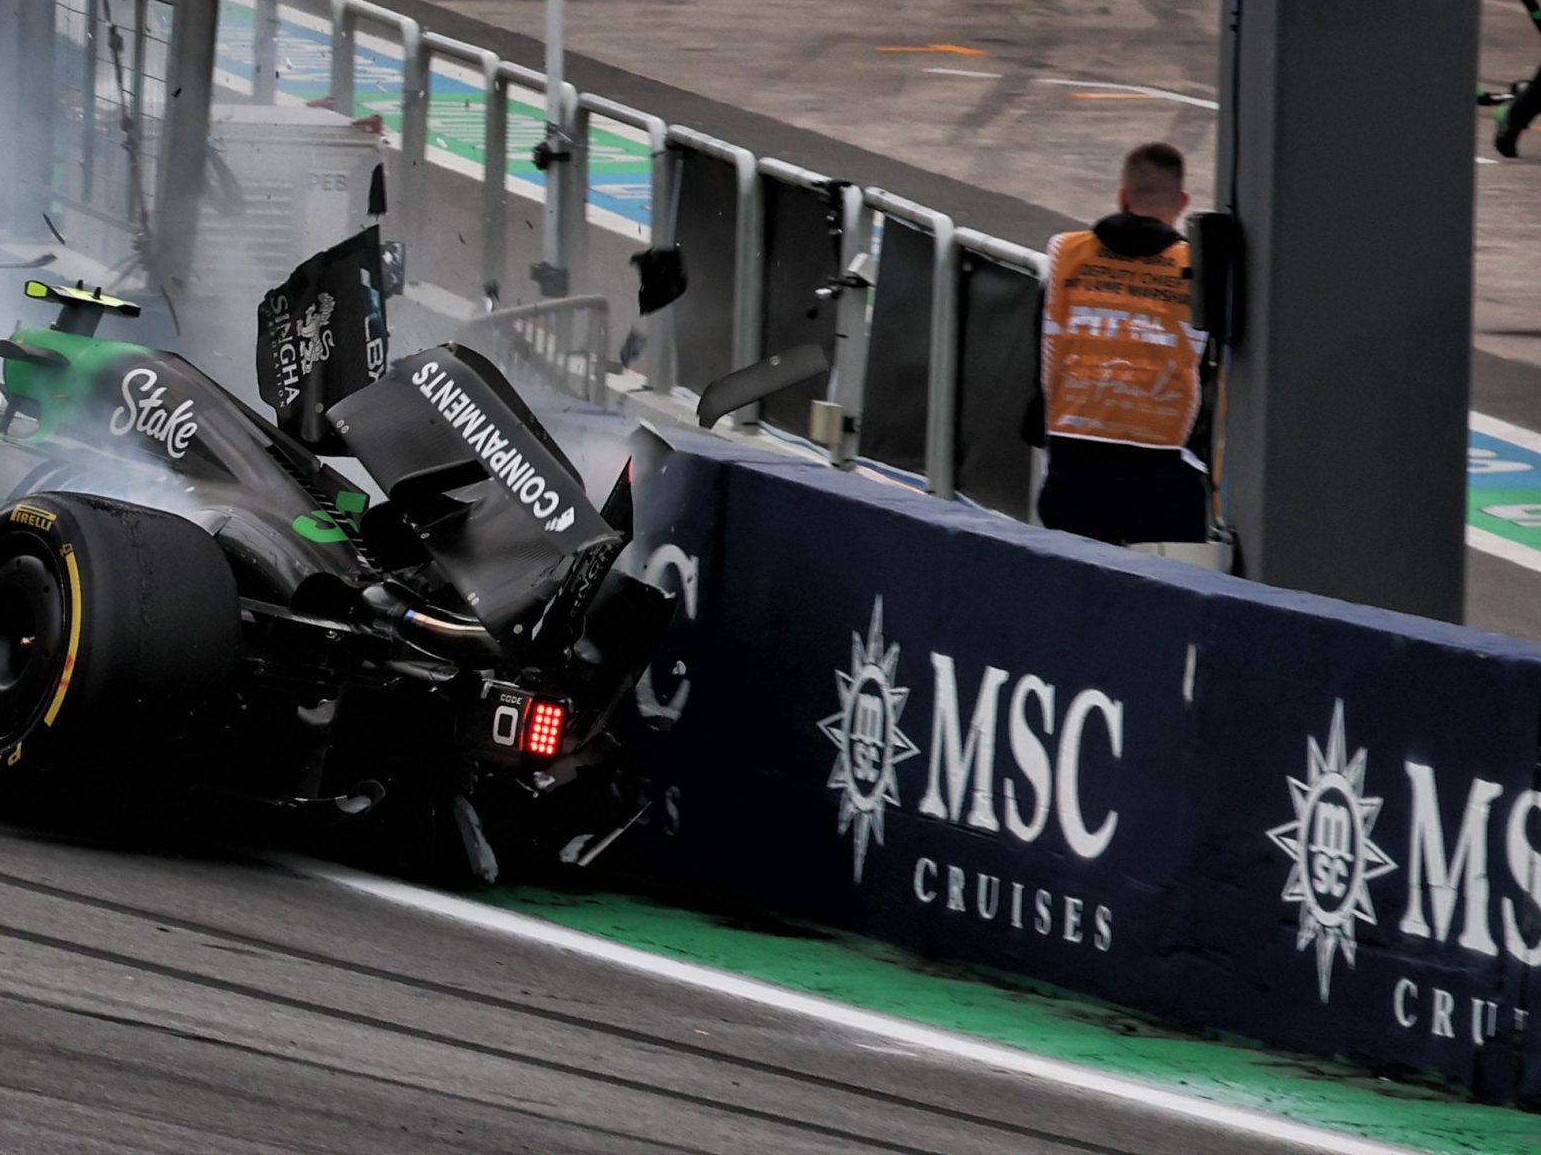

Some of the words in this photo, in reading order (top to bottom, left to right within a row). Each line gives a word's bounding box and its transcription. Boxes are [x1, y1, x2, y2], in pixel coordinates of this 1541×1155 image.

[270, 294, 301, 405] SINGHA
[110, 367, 198, 458] Stake
[412, 361, 560, 519] COINPAYMENTS
[10, 503, 57, 531] PIRELLI
[500, 693, 523, 705] CODE
[918, 651, 1123, 859] MSC
[913, 856, 1114, 952] CRUISES
